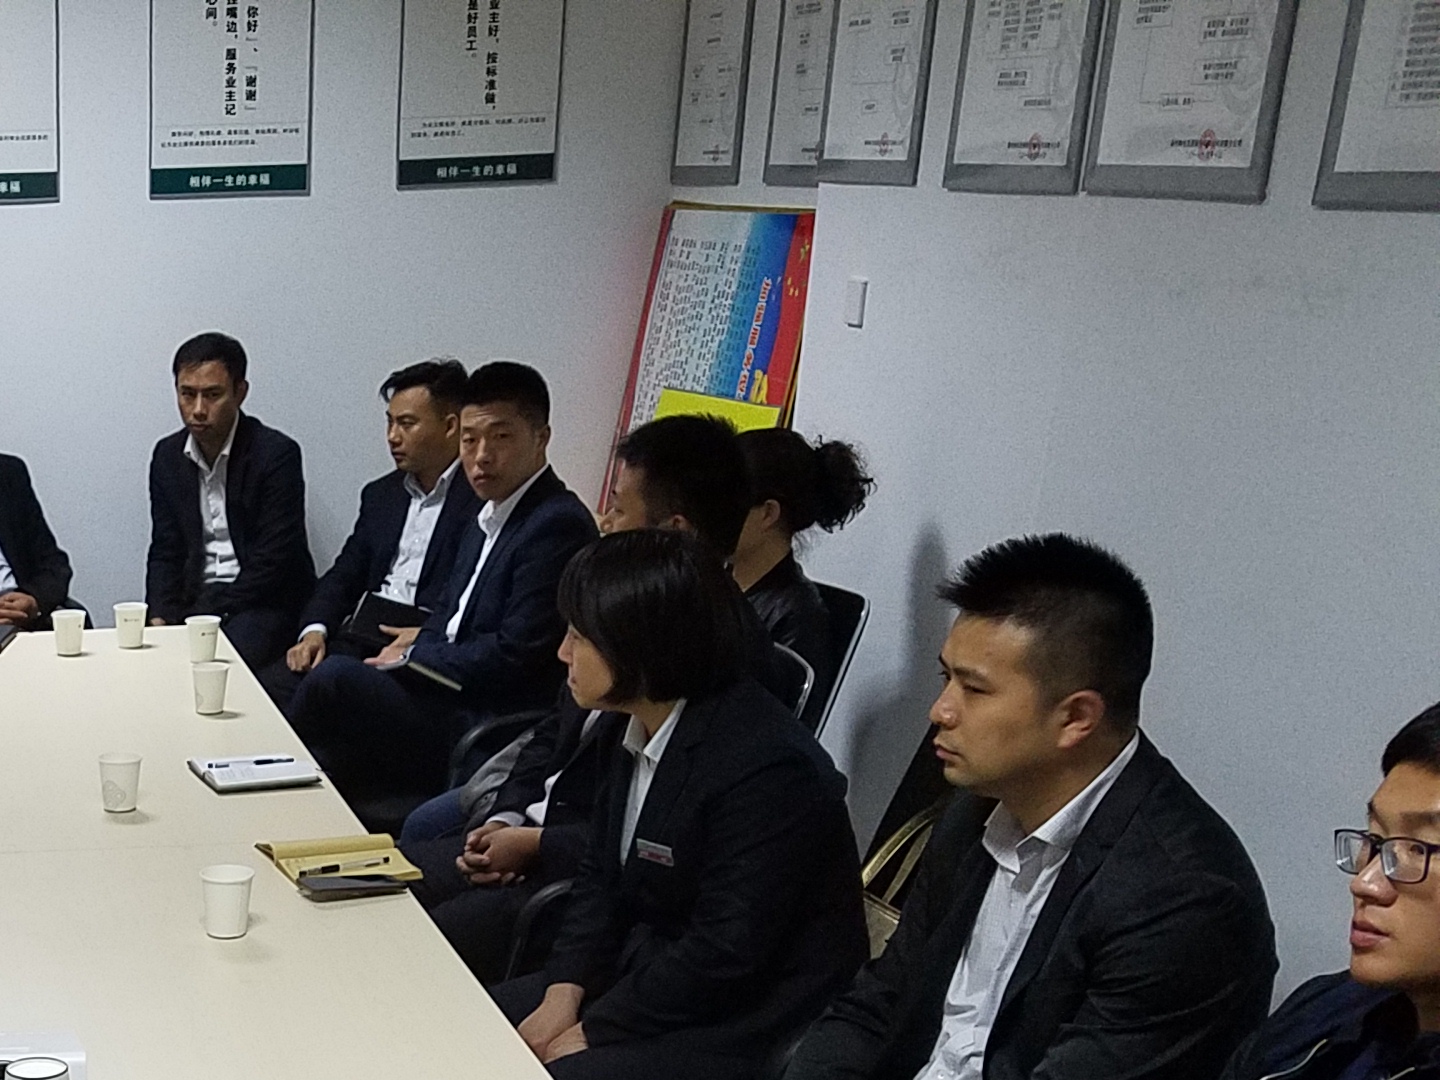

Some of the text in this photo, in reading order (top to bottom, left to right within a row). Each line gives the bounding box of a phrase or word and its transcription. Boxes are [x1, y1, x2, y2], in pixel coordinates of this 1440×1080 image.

[436, 163, 517, 178] 相伴一生的幸福
[189, 173, 270, 188] 相伴一生的幸福
